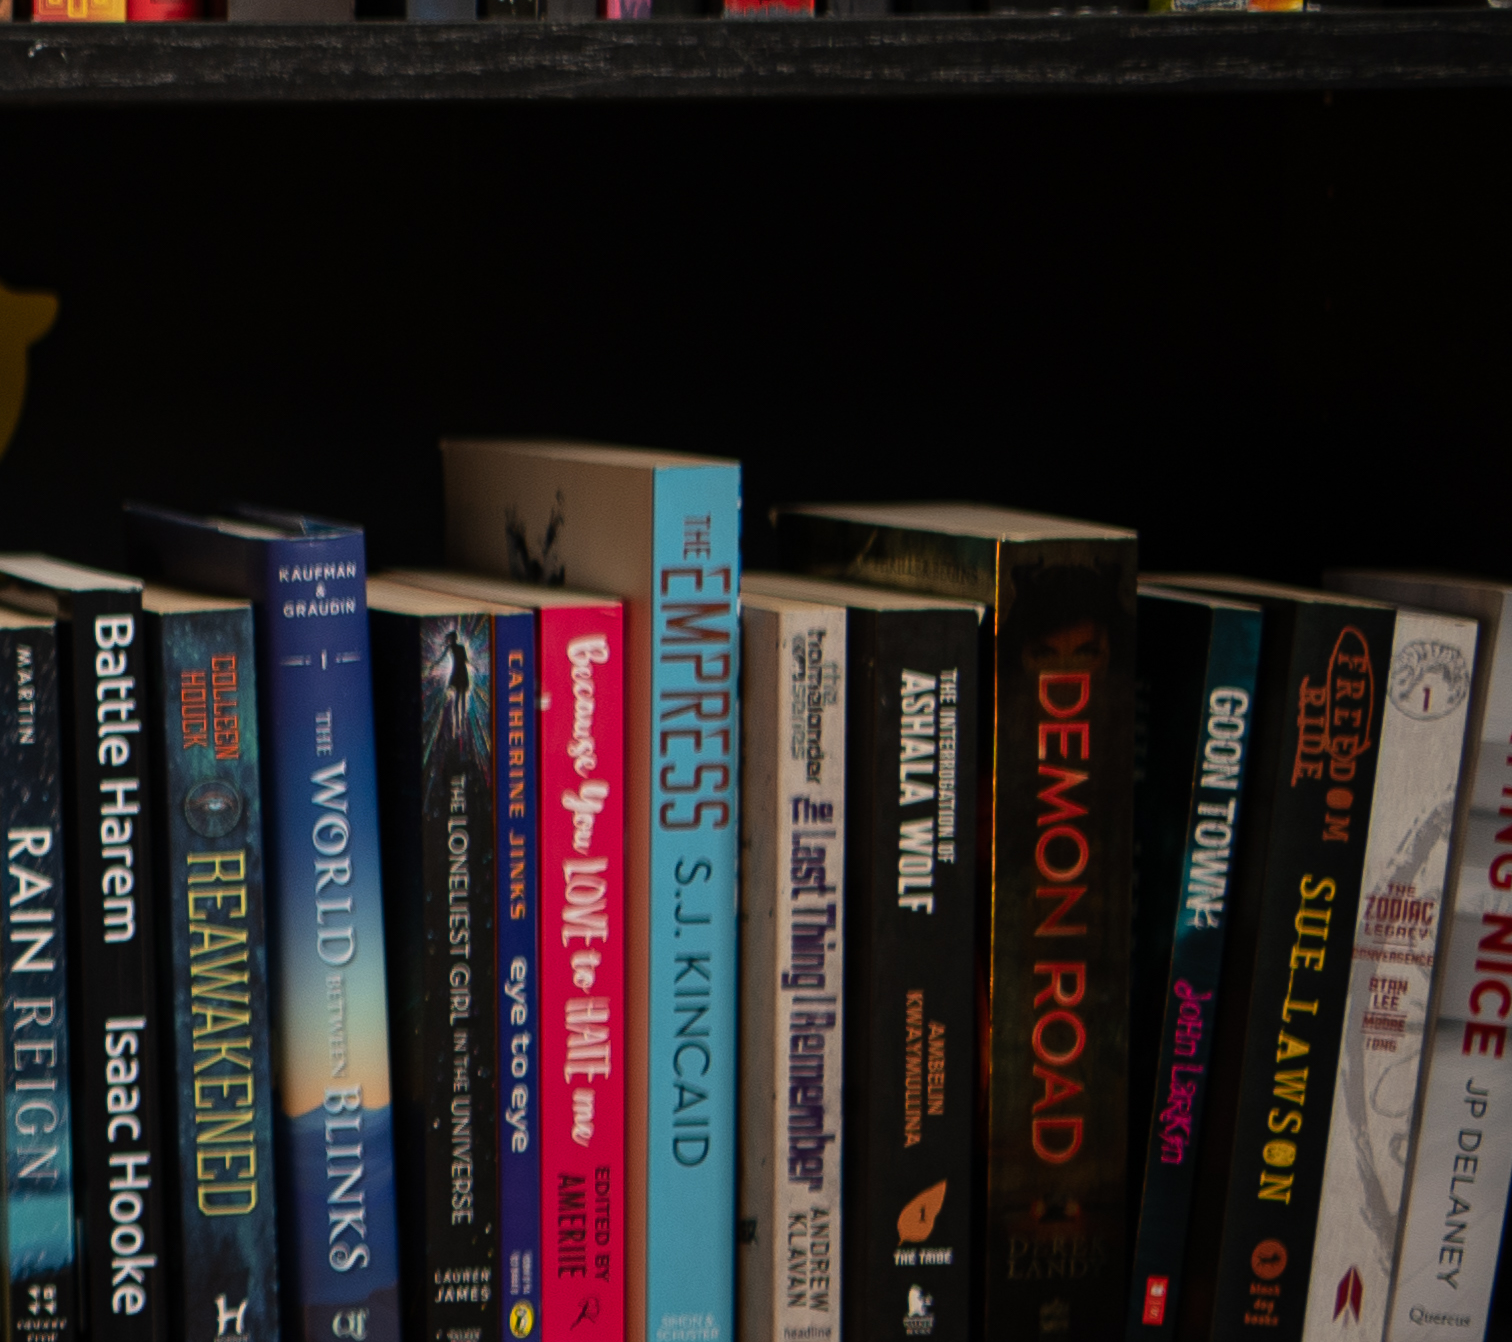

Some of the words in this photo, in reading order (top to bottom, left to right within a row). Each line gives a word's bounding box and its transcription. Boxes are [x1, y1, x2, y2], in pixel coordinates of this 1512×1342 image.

[278, 562, 357, 583] KAUFMAN
[284, 598, 356, 617] GRAUDIN
[94, 613, 140, 767] Battle
[660, 566, 728, 831] EMPRESS
[898, 670, 935, 805] ASHALA
[99, 780, 136, 943] Harem
[311, 759, 355, 967] WORLD
[898, 827, 934, 914] WOLF
[1032, 672, 1091, 935] DEMON
[8, 828, 54, 973] RAIN
[675, 859, 711, 939] S.J.
[1290, 875, 1335, 969] SUE
[15, 997, 56, 1181] REIGN
[105, 1017, 143, 1142] Isaac
[188, 850, 256, 1217] REAWAKENED
[672, 953, 711, 1168] KINCAID
[1031, 962, 1085, 1164] ROAD
[1257, 996, 1320, 1204] LAWSON
[1462, 1077, 1488, 1119] JP
[108, 1153, 145, 1316] Hooke
[323, 1083, 369, 1272] BLINKS
[1434, 1128, 1481, 1289] DELANEY
